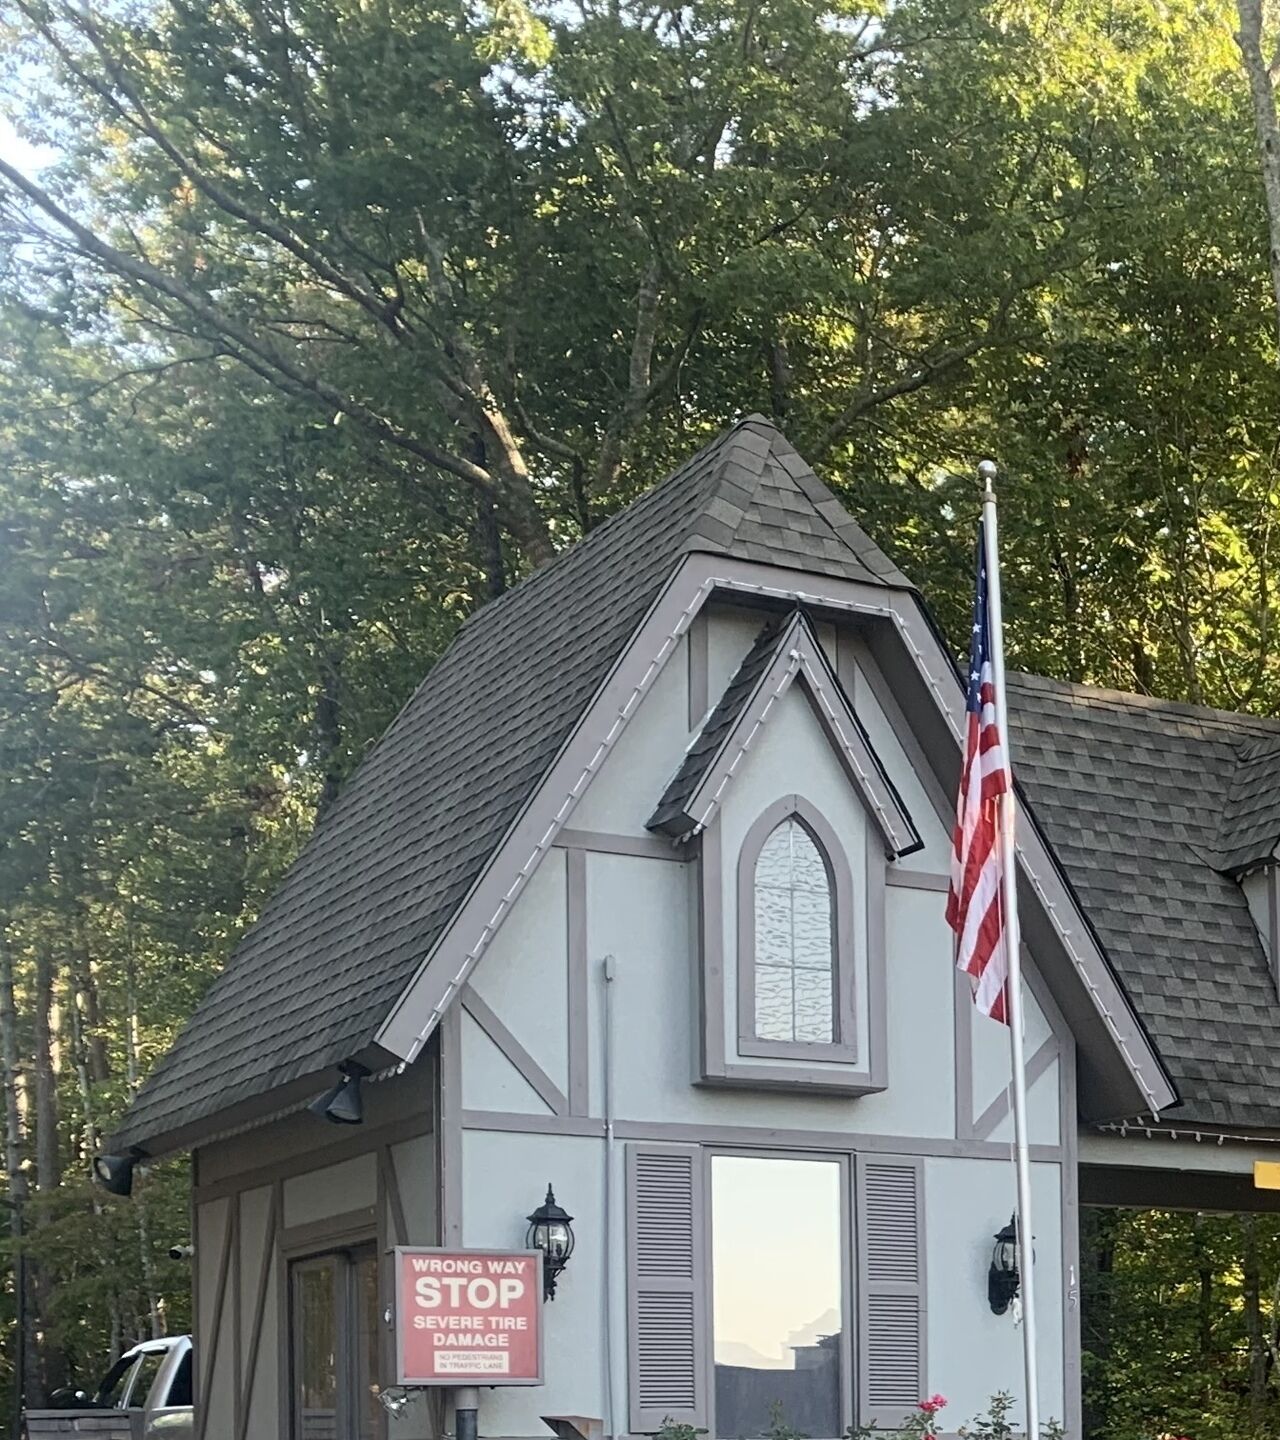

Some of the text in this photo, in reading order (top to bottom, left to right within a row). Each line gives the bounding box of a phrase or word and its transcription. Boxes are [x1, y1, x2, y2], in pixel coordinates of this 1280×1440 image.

[412, 1259, 526, 1275] WRONG WAY
[415, 1277, 525, 1309] STOP
[413, 1315, 528, 1330] SEVERE TIRE
[433, 1333, 509, 1347] DAMAGE
[439, 1353, 451, 1361] NO
